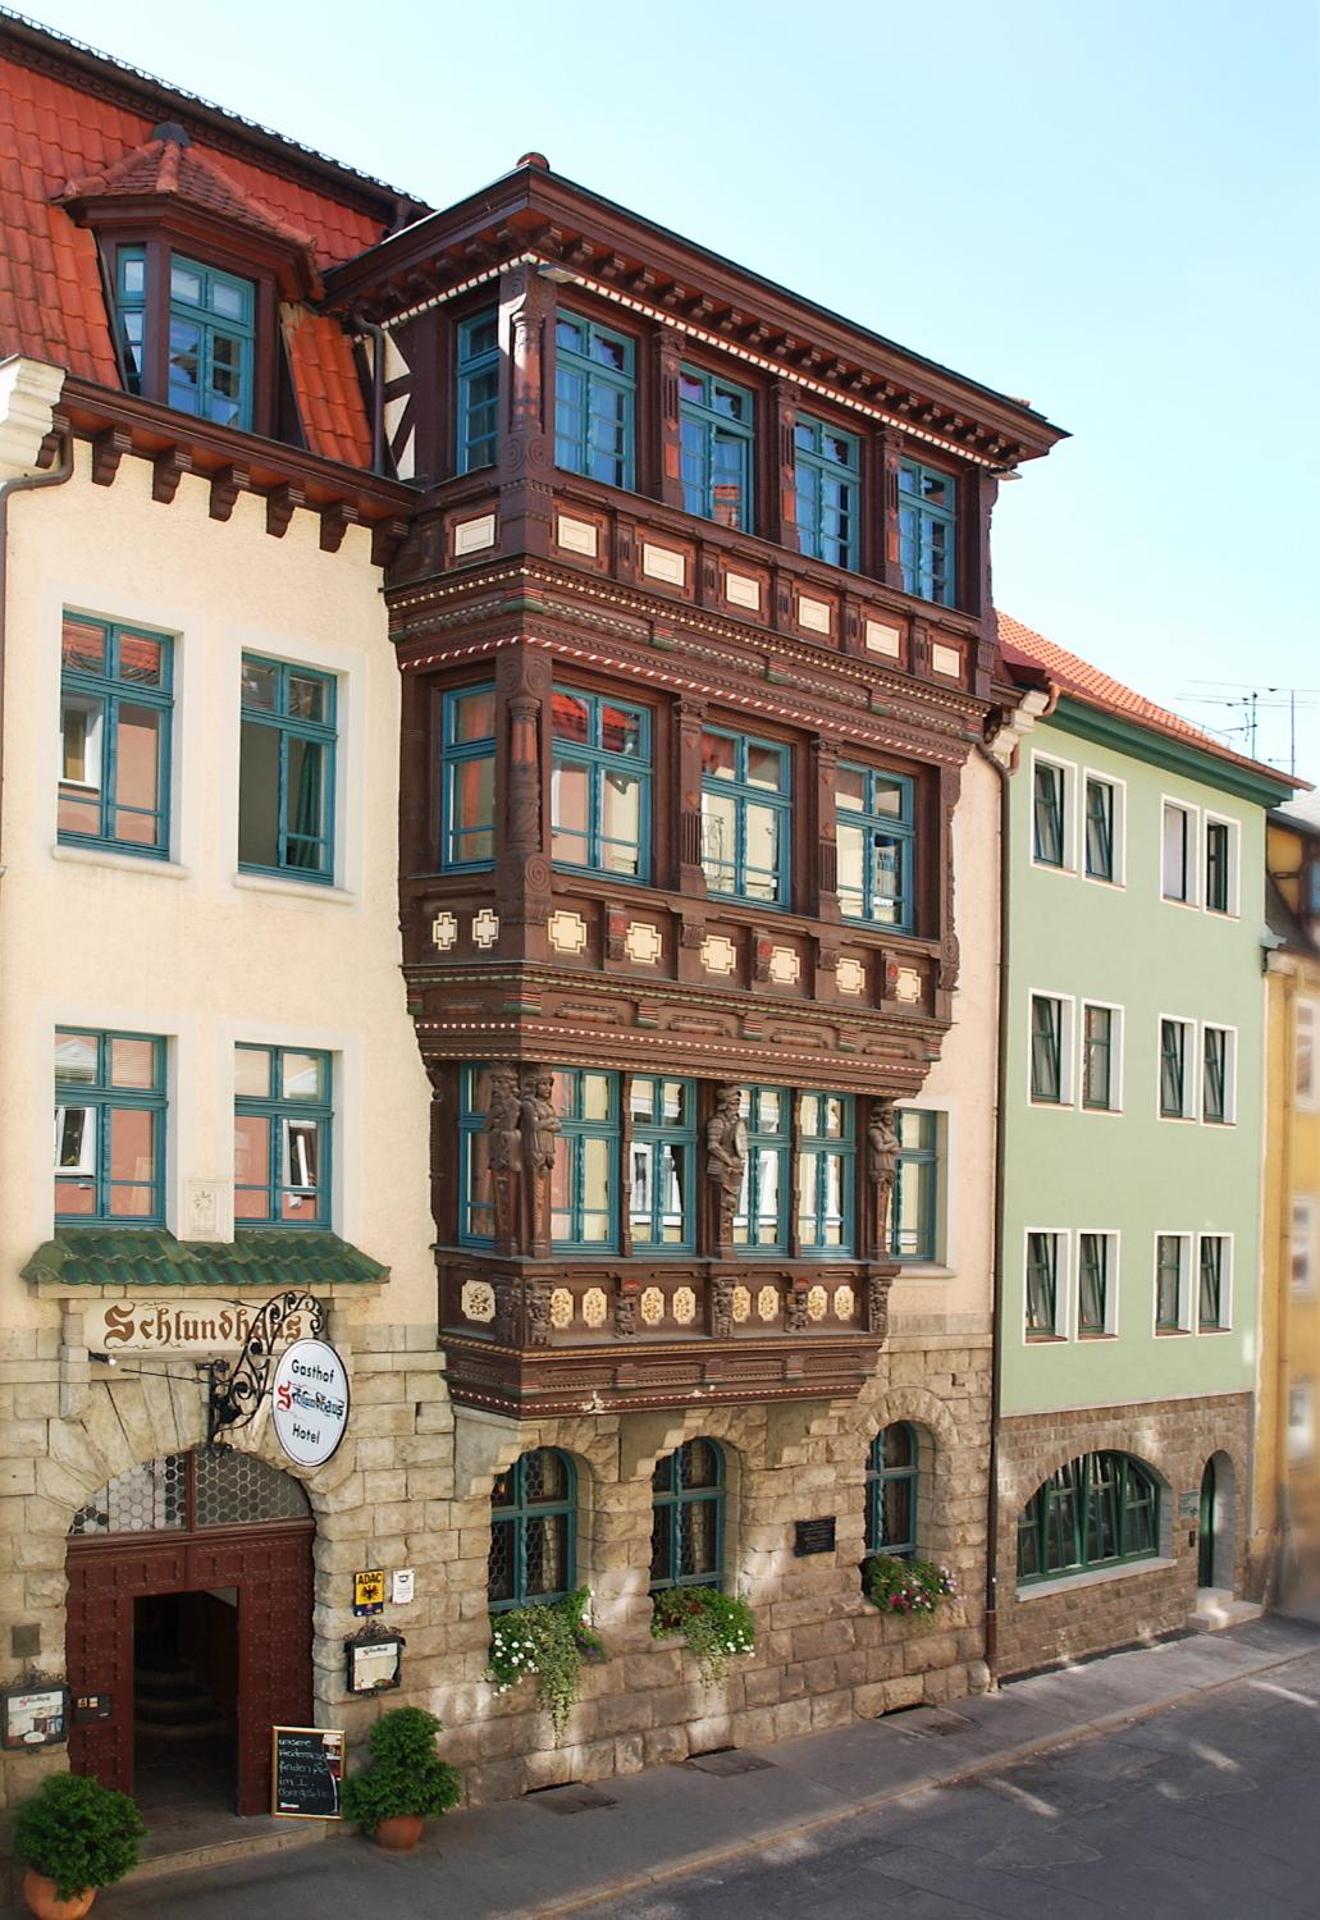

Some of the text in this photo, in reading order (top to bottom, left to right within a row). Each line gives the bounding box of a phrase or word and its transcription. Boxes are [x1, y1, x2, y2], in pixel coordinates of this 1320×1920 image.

[291, 1359, 334, 1383] Gasthof
[292, 1423, 320, 1444] Hotel
[357, 1572, 382, 1584] ADAC
